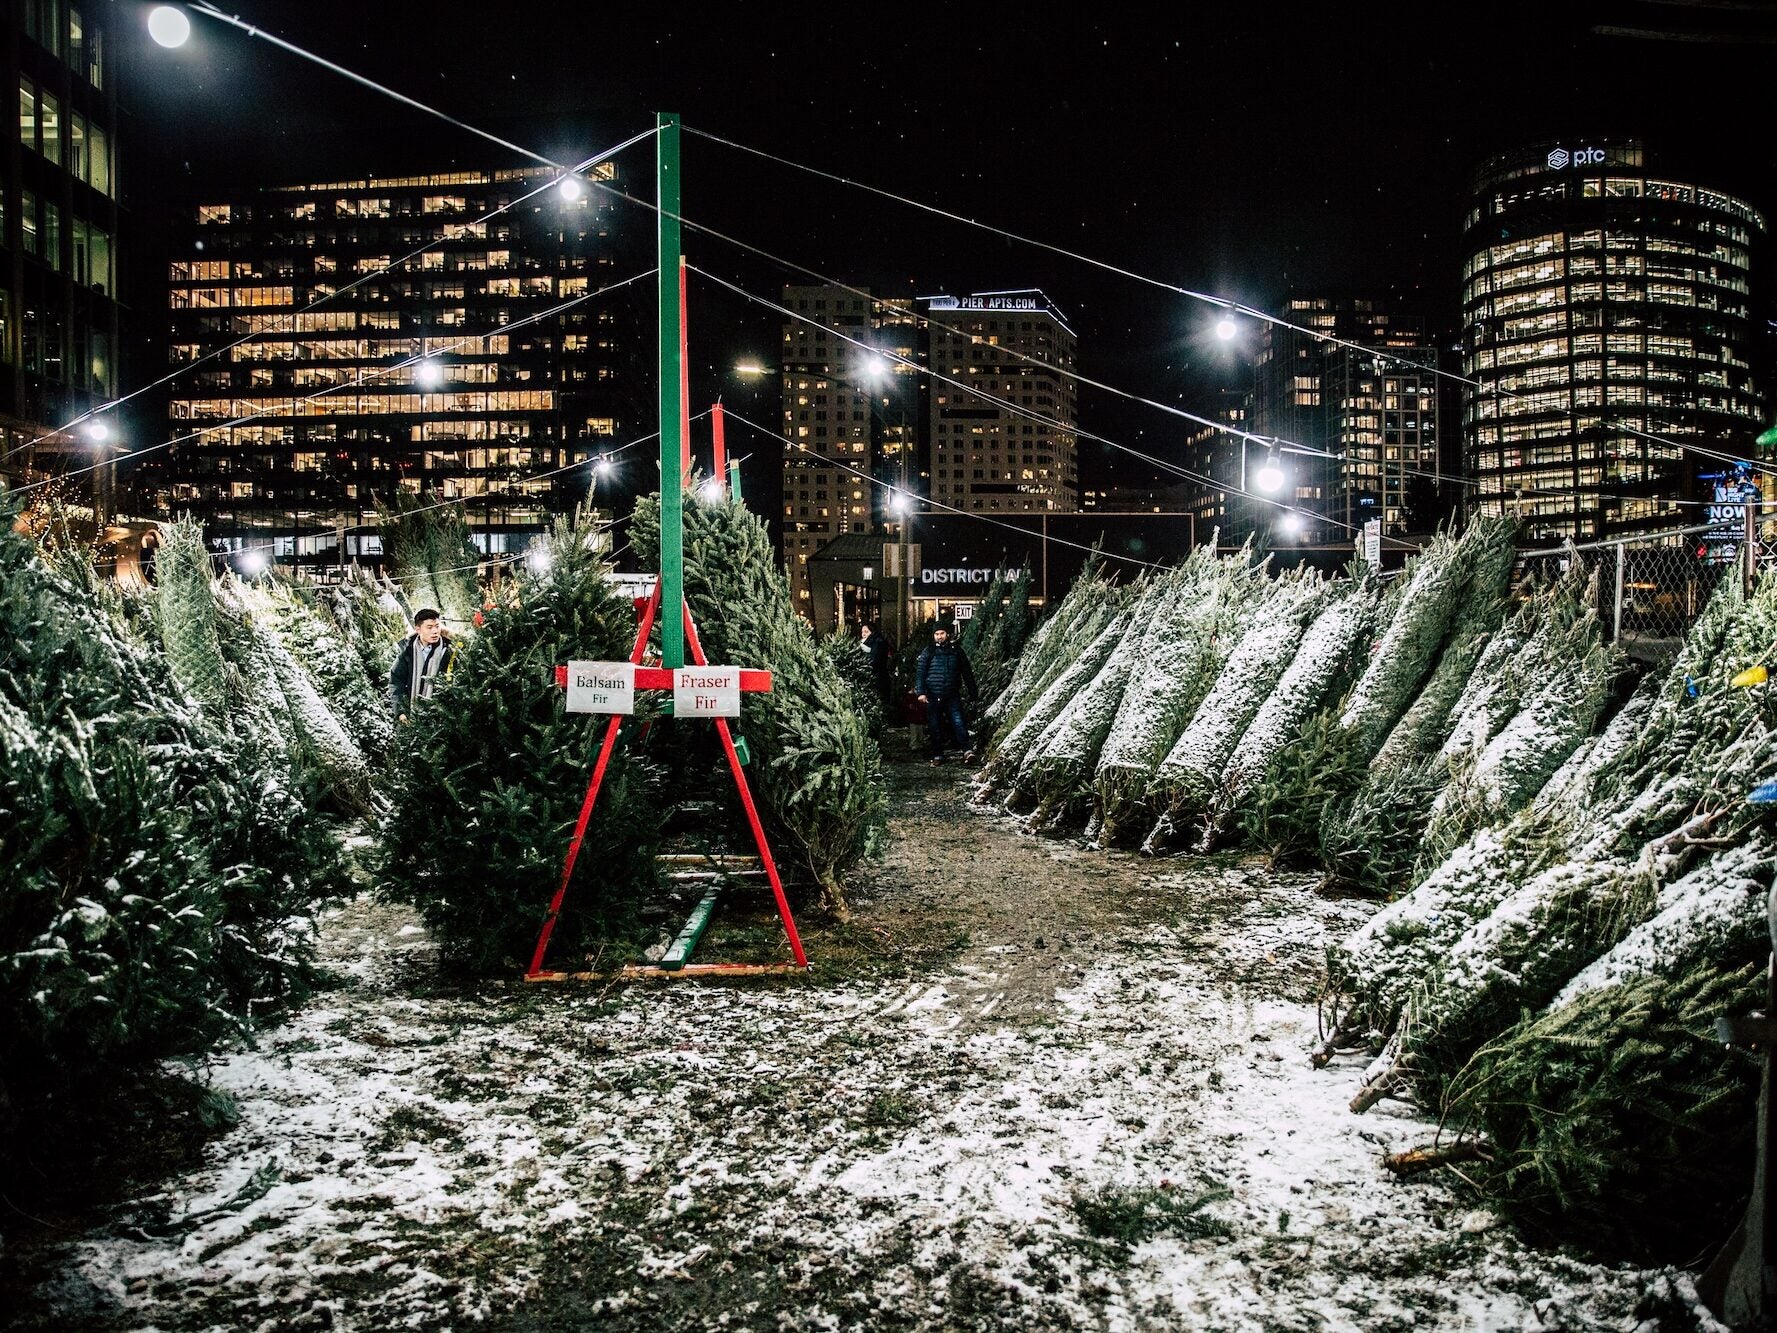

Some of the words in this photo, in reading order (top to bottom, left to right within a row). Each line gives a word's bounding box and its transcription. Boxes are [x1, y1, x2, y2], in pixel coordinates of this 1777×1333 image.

[1574, 147, 1605, 167] ptc
[922, 568, 991, 583] DISTRICT
[956, 607, 971, 617] EXIT
[576, 675, 625, 689] Balsam
[681, 674, 731, 688] Fraser
[592, 694, 609, 704] Fir
[695, 696, 717, 709] Fir
